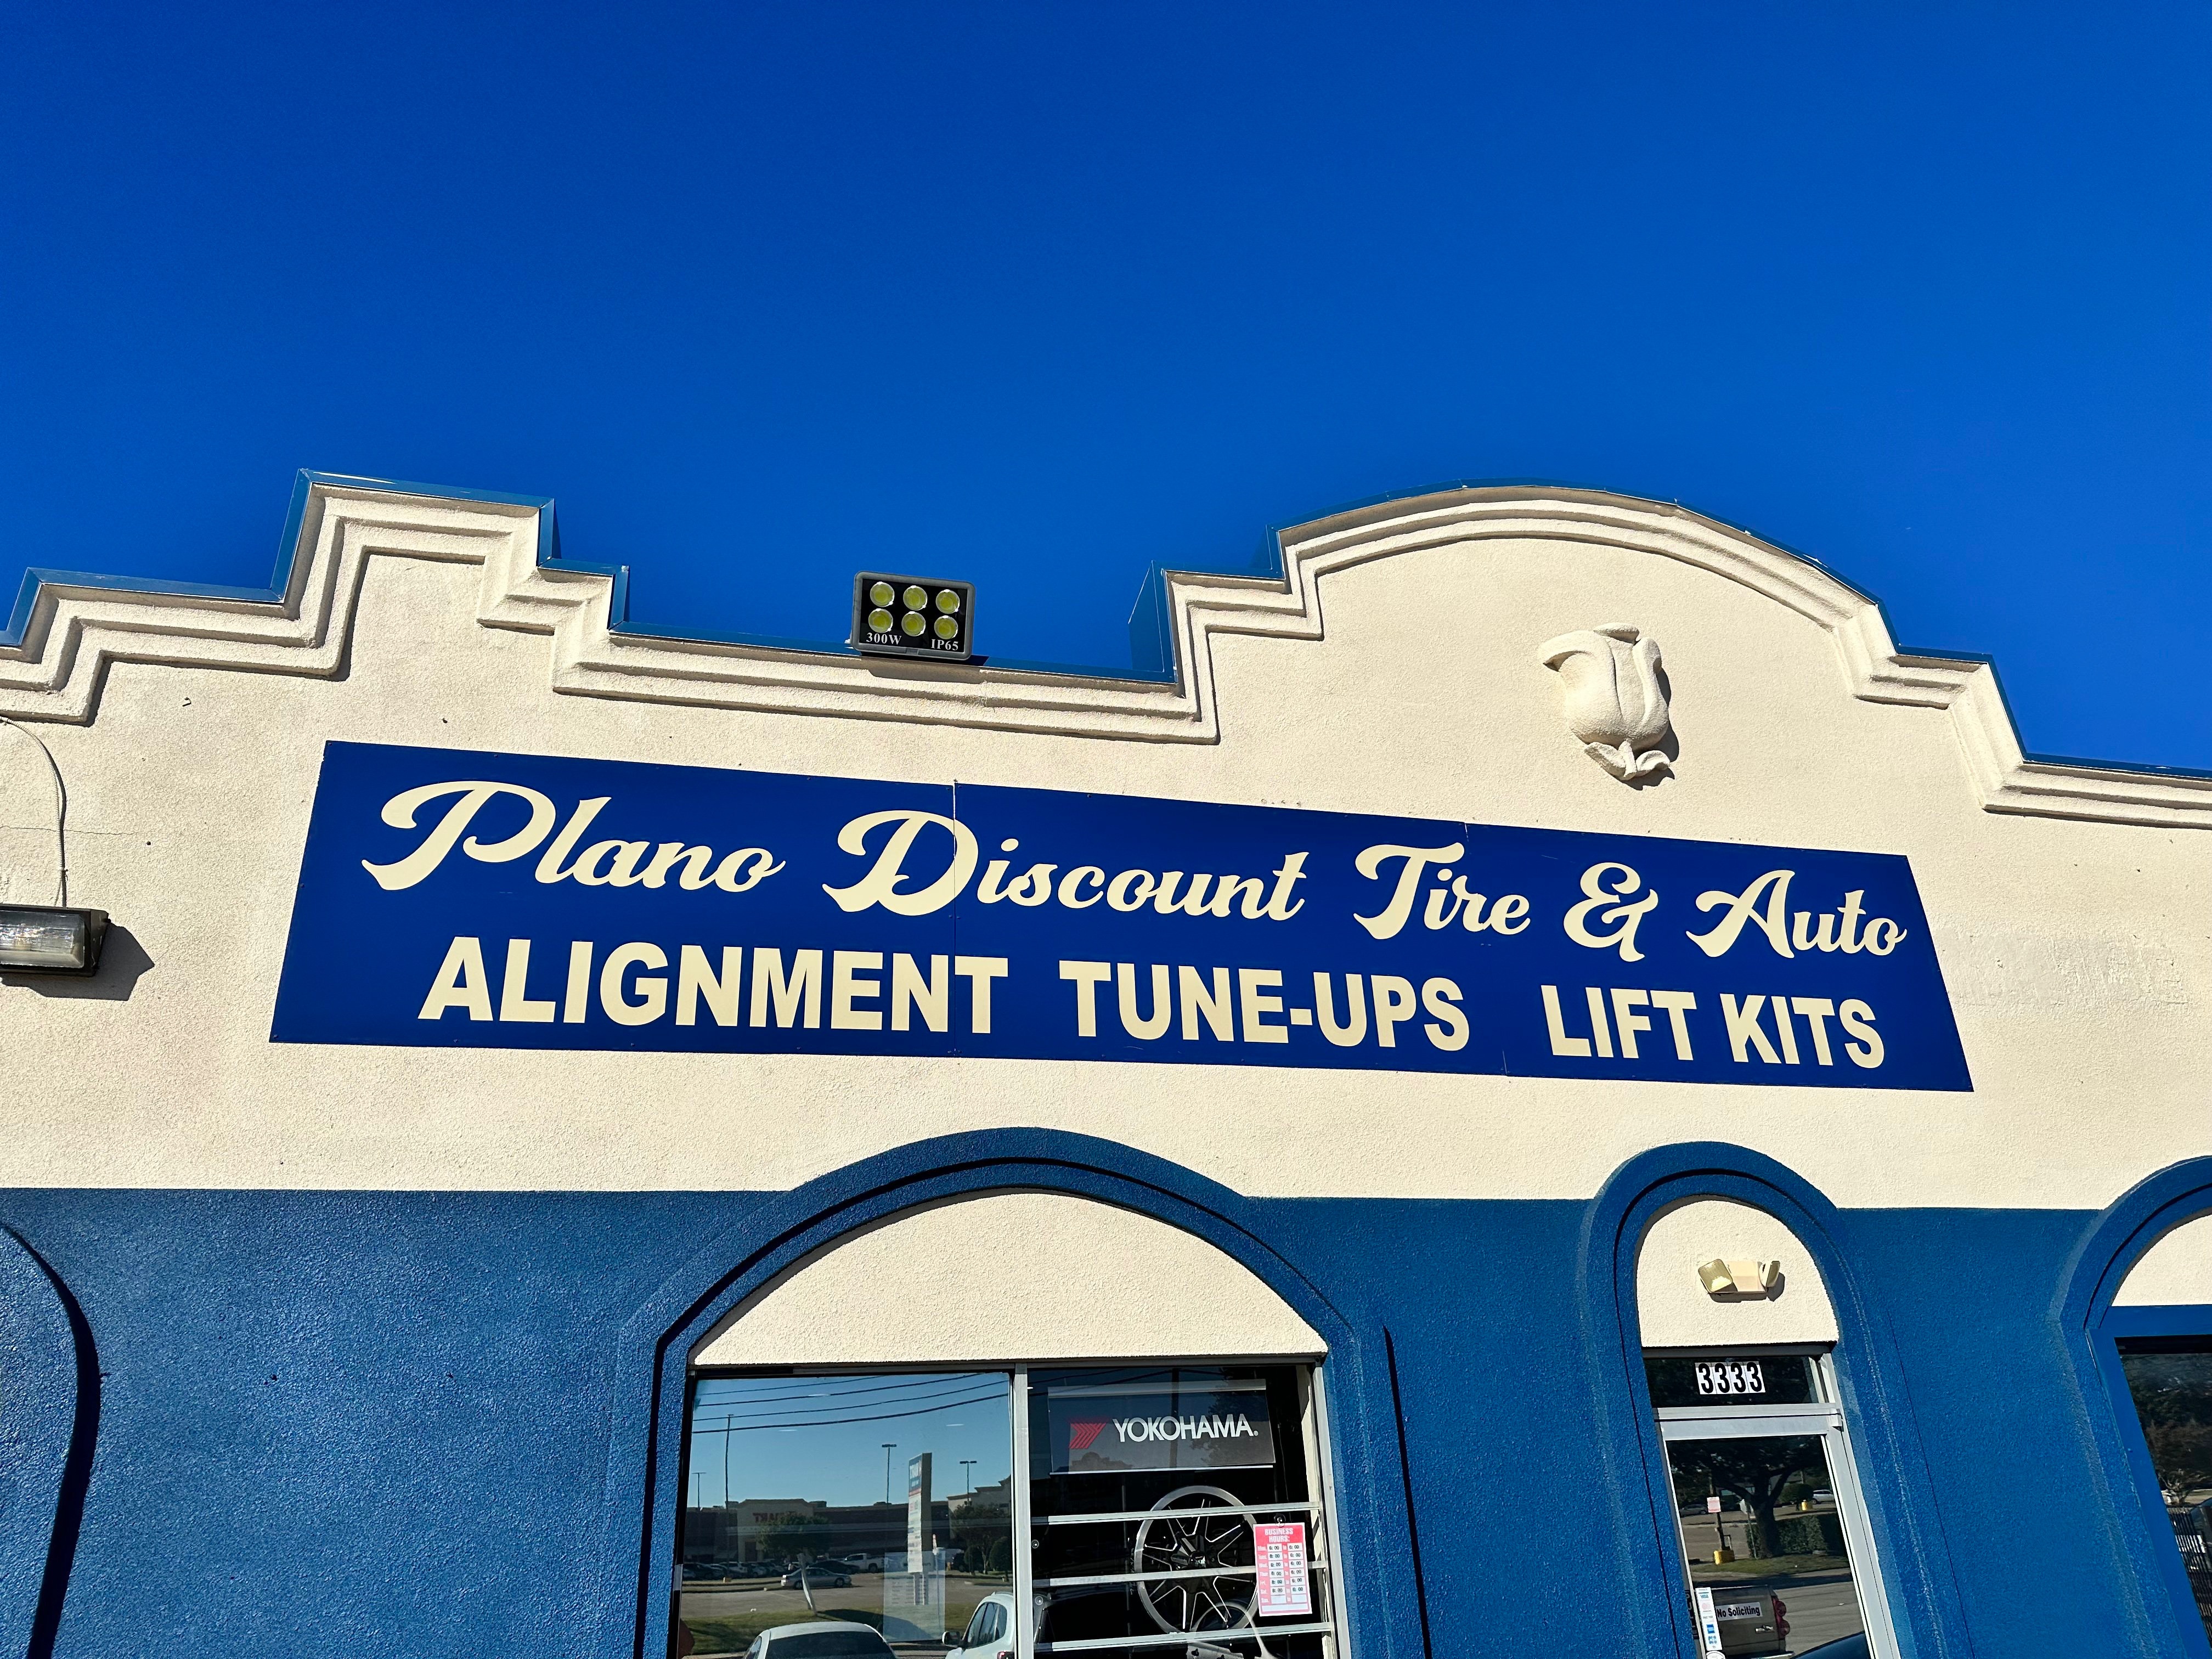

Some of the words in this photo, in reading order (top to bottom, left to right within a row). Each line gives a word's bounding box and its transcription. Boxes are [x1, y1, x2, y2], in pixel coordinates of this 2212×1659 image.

[866, 633, 902, 645] 300W
[931, 639, 958, 651] IP65
[362, 781, 786, 892] Plano
[822, 810, 1309, 921] Discount
[1353, 843, 1530, 939] Tire
[1564, 862, 1658, 962] &
[1686, 870, 1907, 958] Auto
[418, 937, 1008, 1033] ALIGNMENT
[1059, 961, 1469, 1051] TUNE-UPS
[1541, 985, 1696, 1060] LIFT
[1720, 994, 1884, 1068] KITS
[1698, 1362, 1762, 1393] 3333
[1113, 1413, 1254, 1442] YOKOHAMA
[1717, 1609, 1726, 1617] No
[1728, 1606, 1760, 1616] Soliciting
